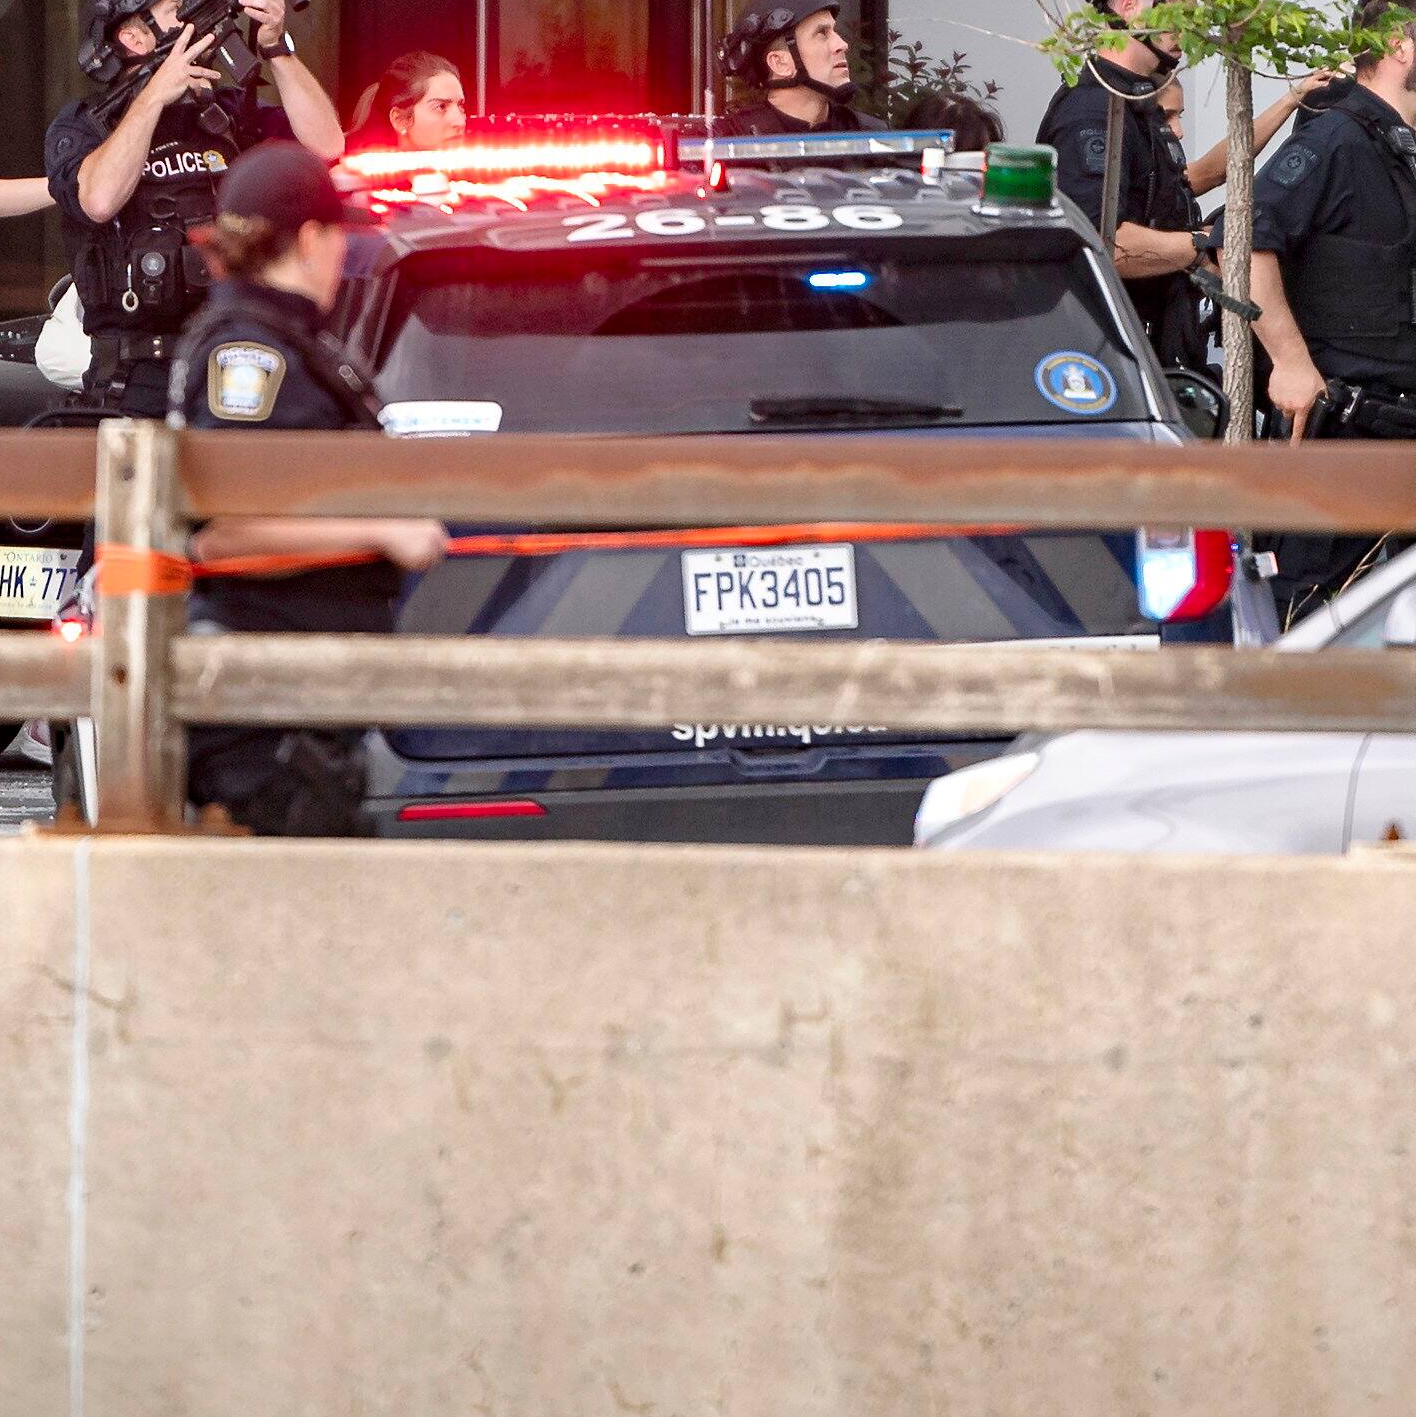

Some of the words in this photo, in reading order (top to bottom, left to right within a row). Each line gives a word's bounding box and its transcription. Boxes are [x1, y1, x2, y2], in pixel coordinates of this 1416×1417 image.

[142, 151, 207, 178] POLICE
[561, 204, 903, 242] 26-86
[6, 551, 53, 564] ONTARIO
[694, 567, 845, 611] FPK3405
